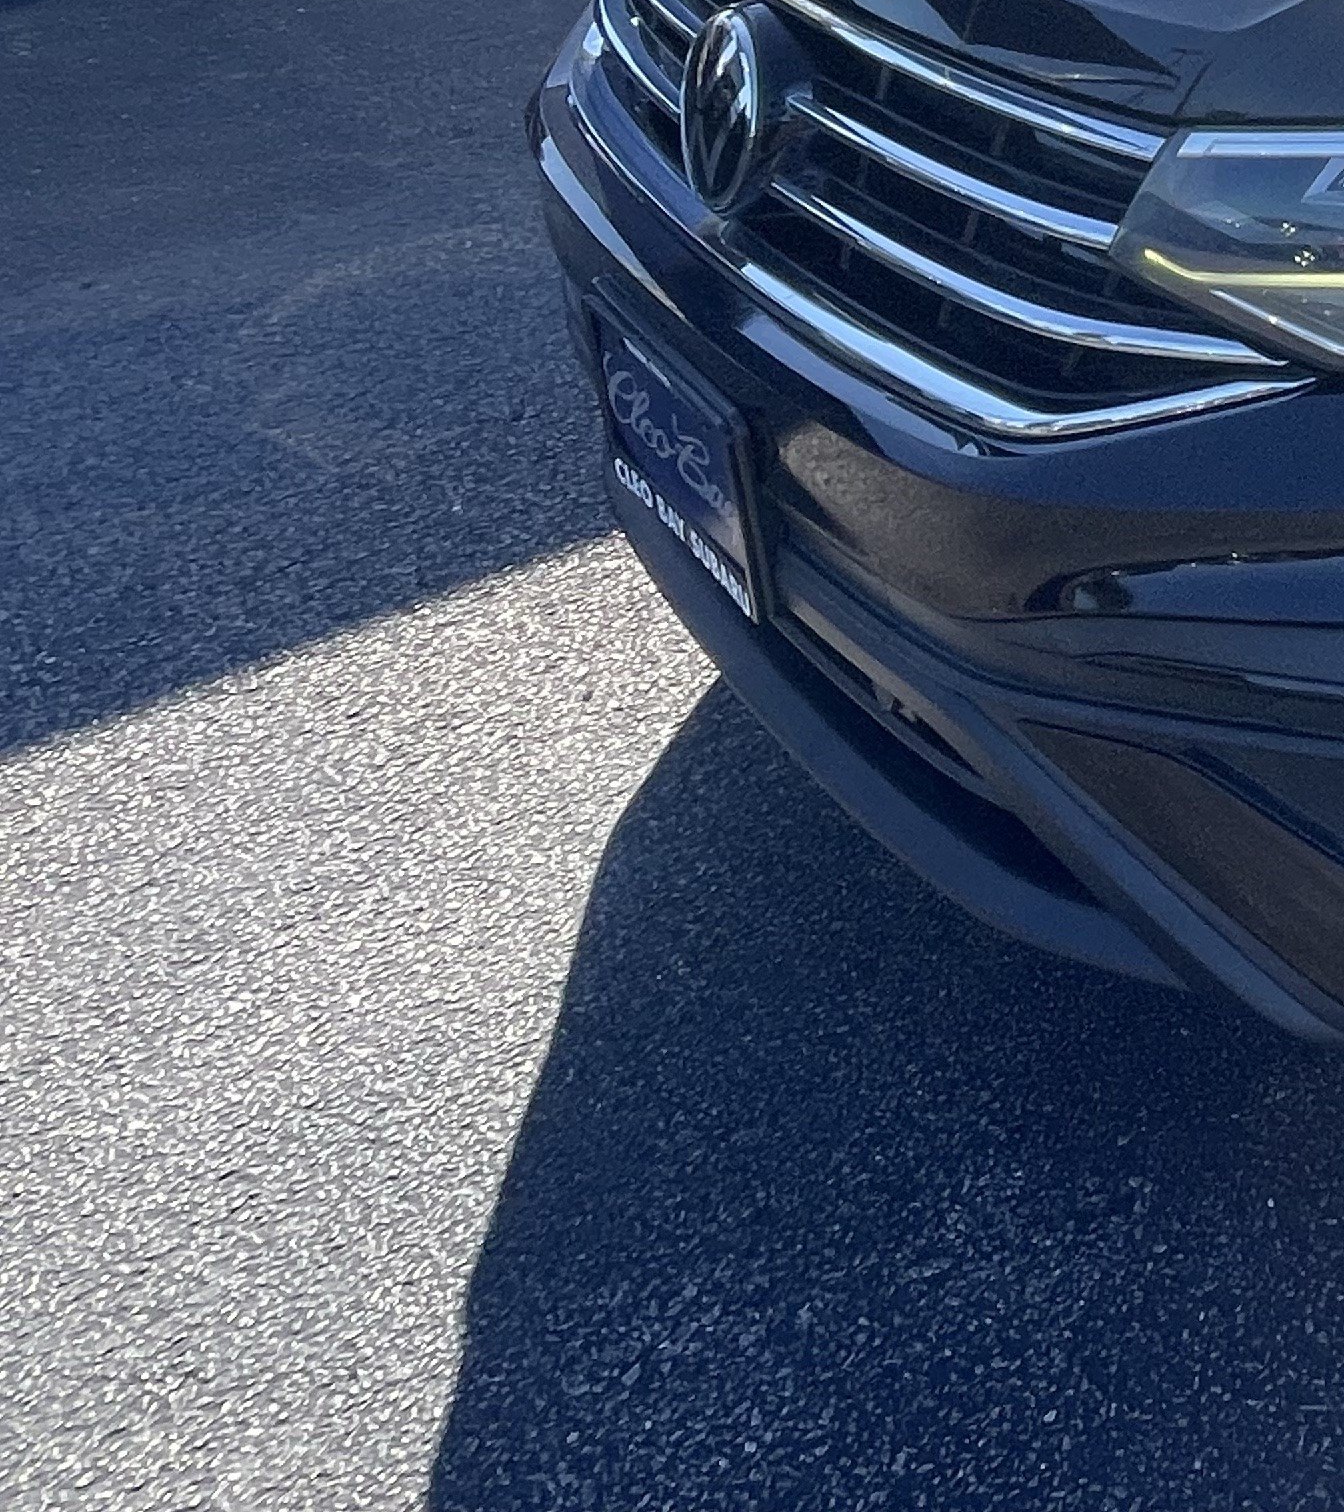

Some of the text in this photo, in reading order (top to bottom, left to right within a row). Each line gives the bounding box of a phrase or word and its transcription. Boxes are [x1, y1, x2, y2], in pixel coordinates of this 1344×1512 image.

[614, 457, 752, 618] CLEO BAY SUBARU
